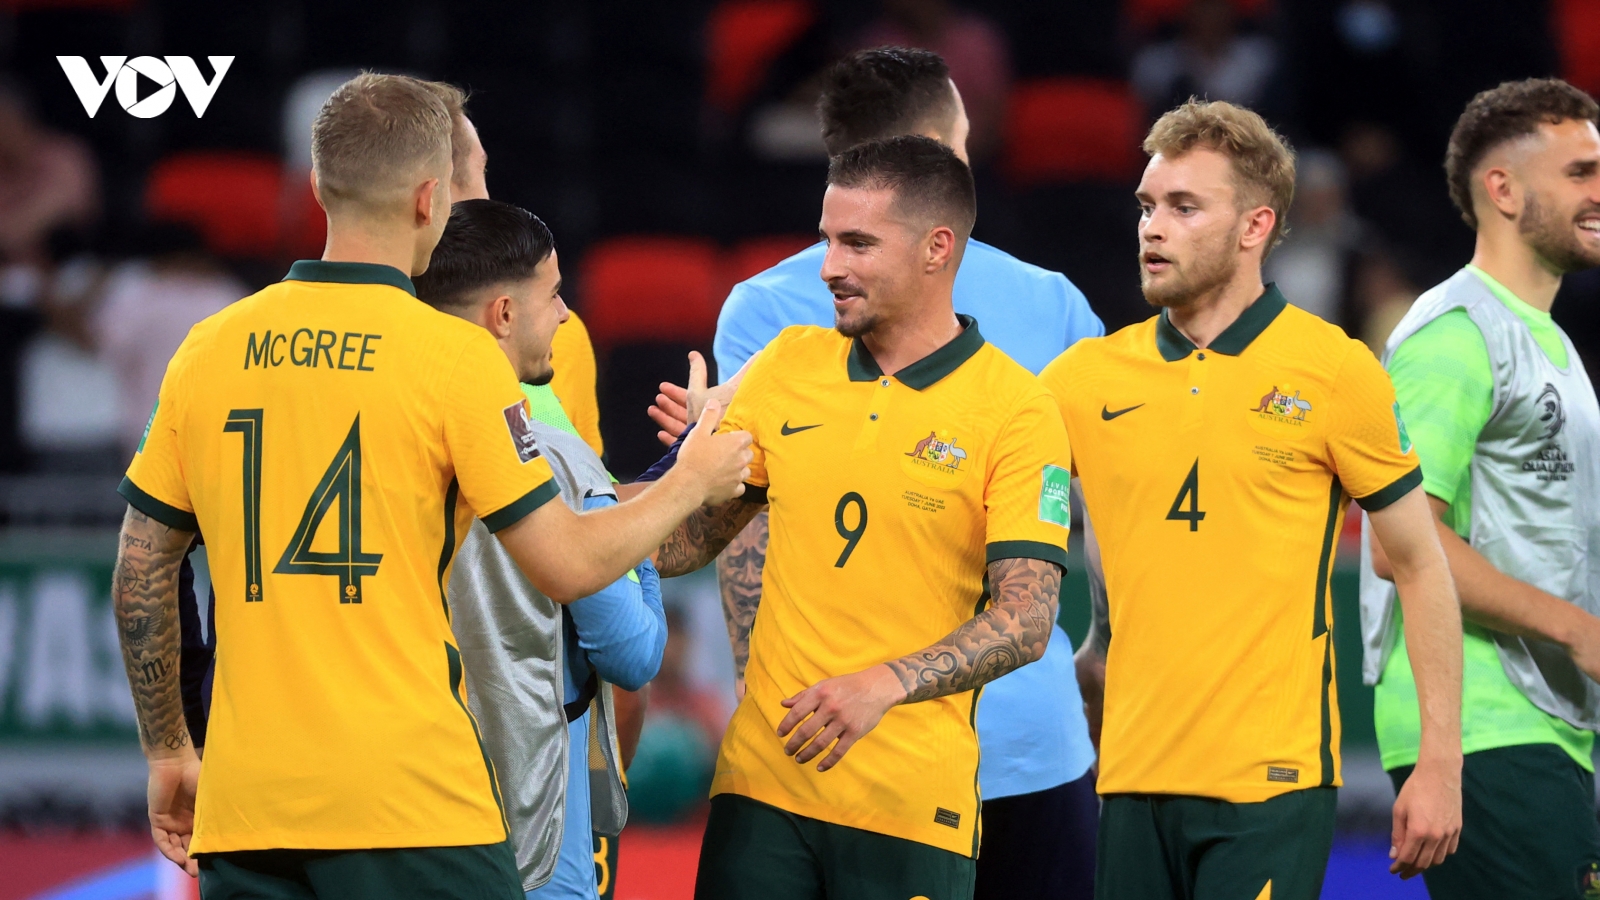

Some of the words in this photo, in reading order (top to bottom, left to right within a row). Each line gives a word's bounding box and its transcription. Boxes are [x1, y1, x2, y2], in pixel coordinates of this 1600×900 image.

[1258, 413, 1302, 426] AUSTRALIA
[911, 459, 955, 475] AUSTRALIA
[901, 494, 921, 503] TUESDAY
[905, 490, 929, 501] AUSTRALIA
[1165, 455, 1207, 532] 4
[223, 408, 383, 604] 14
[833, 491, 869, 568] 9
